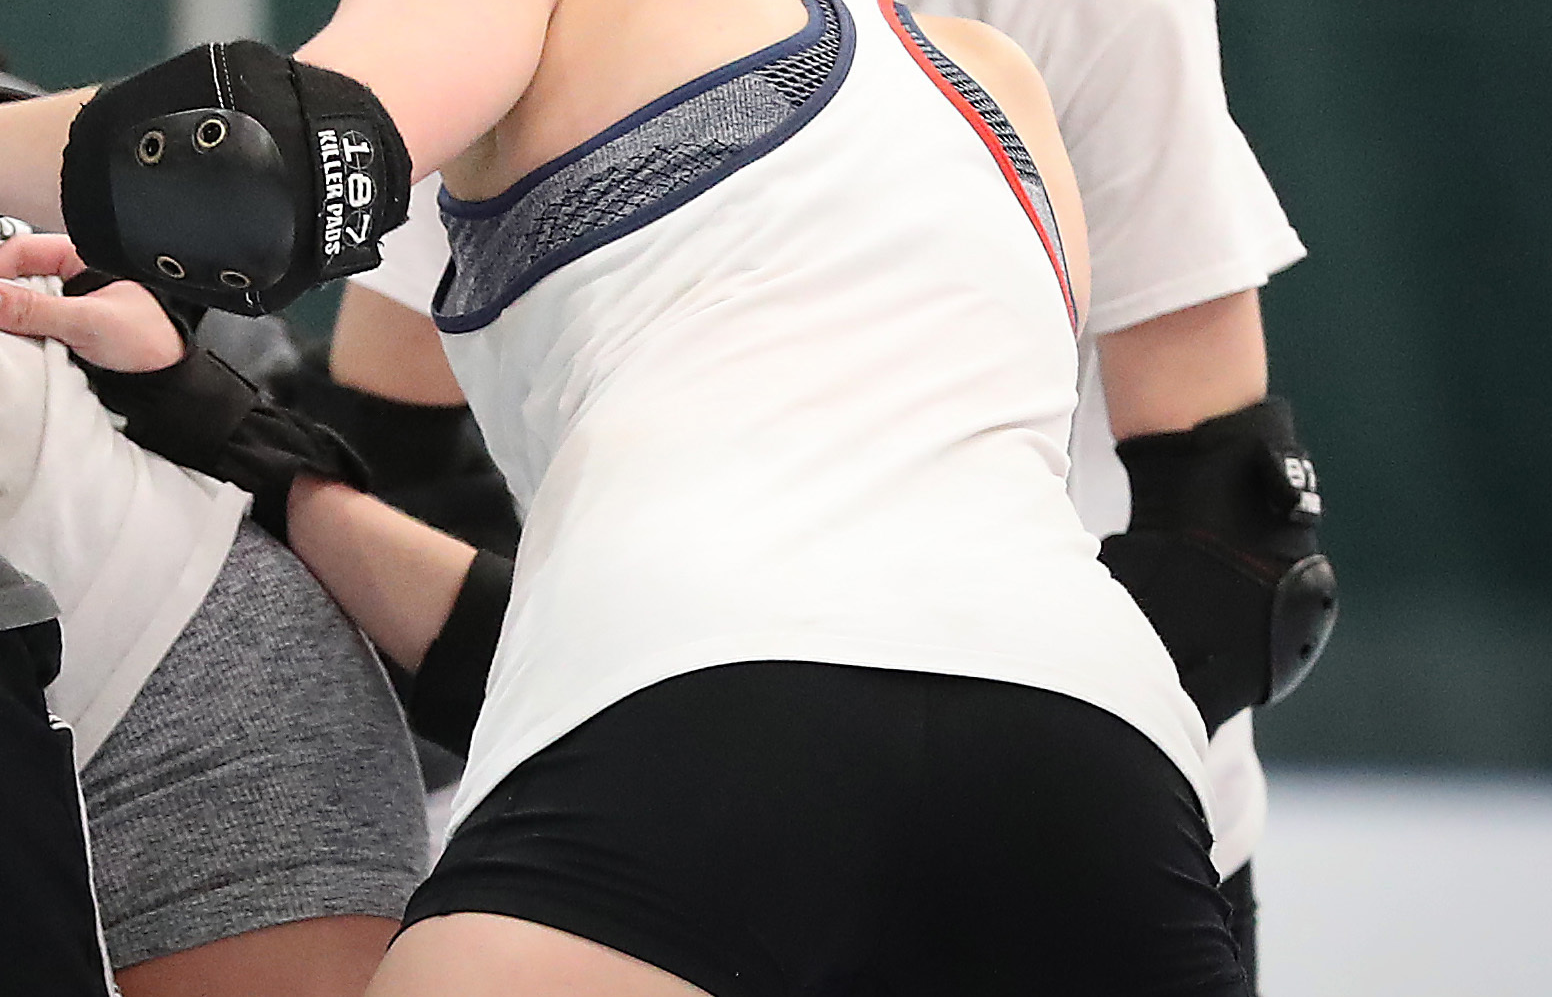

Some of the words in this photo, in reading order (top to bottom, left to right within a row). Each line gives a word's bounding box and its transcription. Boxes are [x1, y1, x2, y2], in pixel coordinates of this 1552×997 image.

[317, 129, 343, 200] KILLER
[342, 137, 372, 244] 187
[324, 203, 344, 255] PADS
